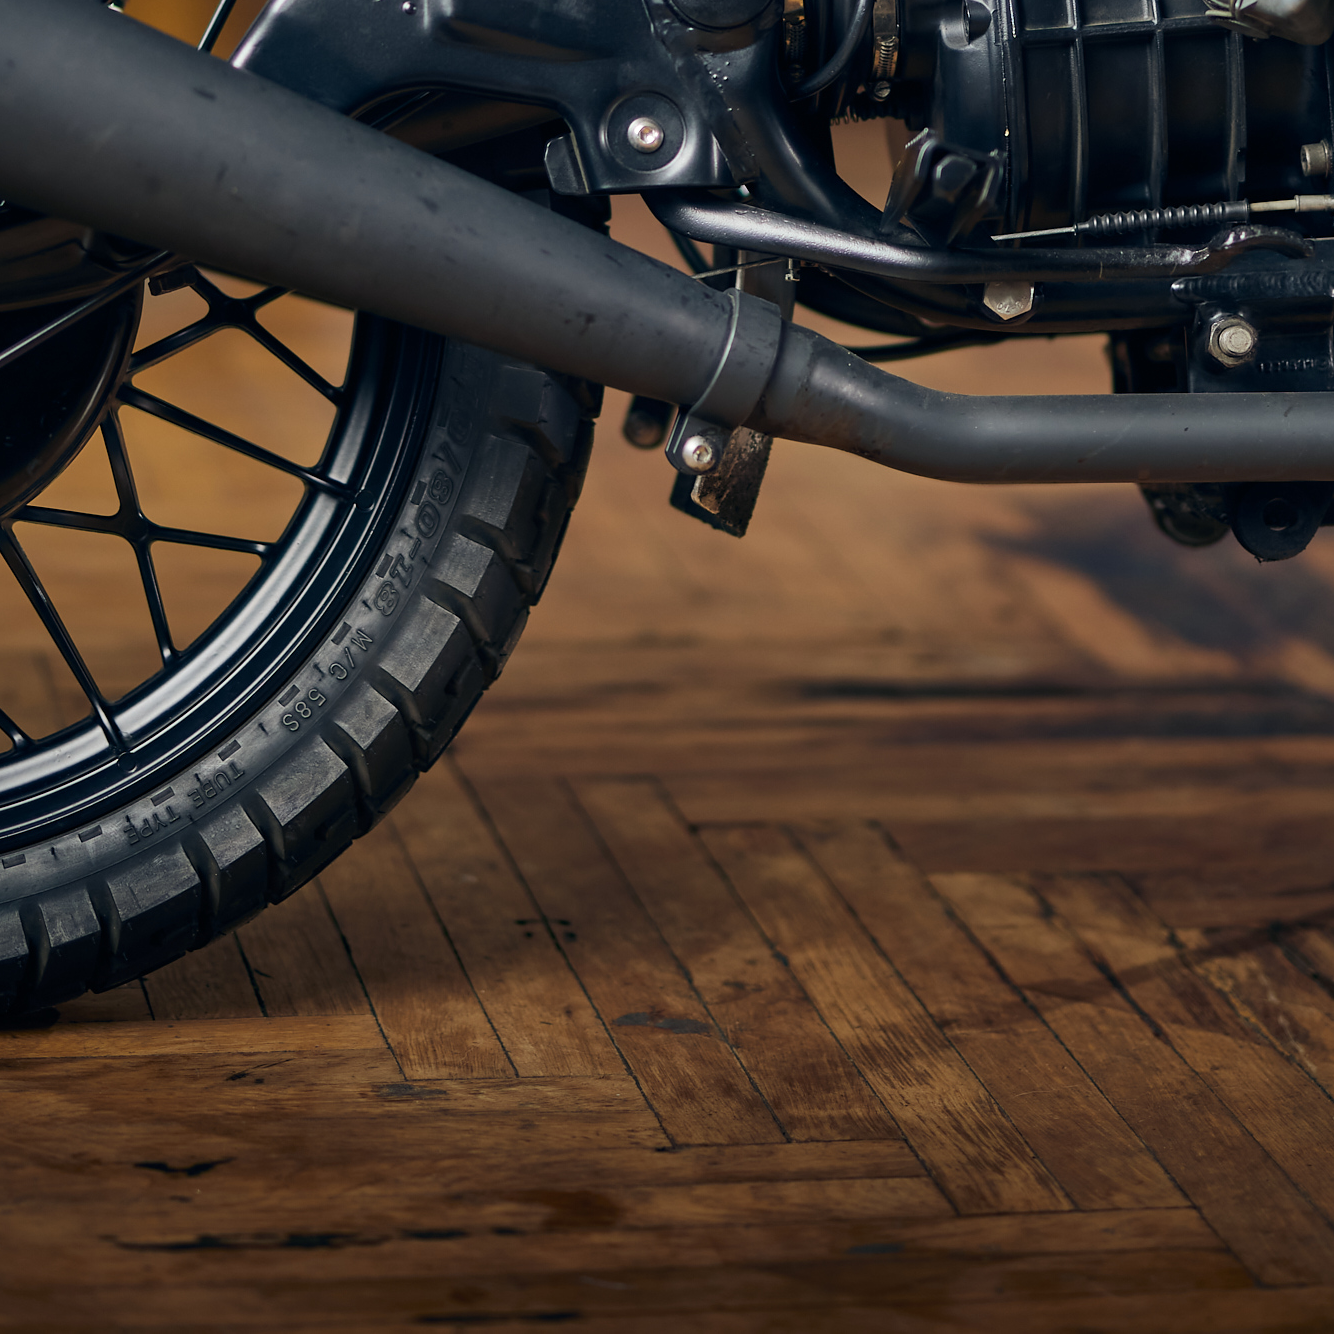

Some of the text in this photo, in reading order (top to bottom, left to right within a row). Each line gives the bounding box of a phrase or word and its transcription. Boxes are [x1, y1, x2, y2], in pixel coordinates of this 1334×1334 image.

[327, 629, 374, 682] M/C
[282, 687, 327, 733] 58S
[187, 762, 246, 809] TUBE
[123, 804, 181, 846] TYPE
